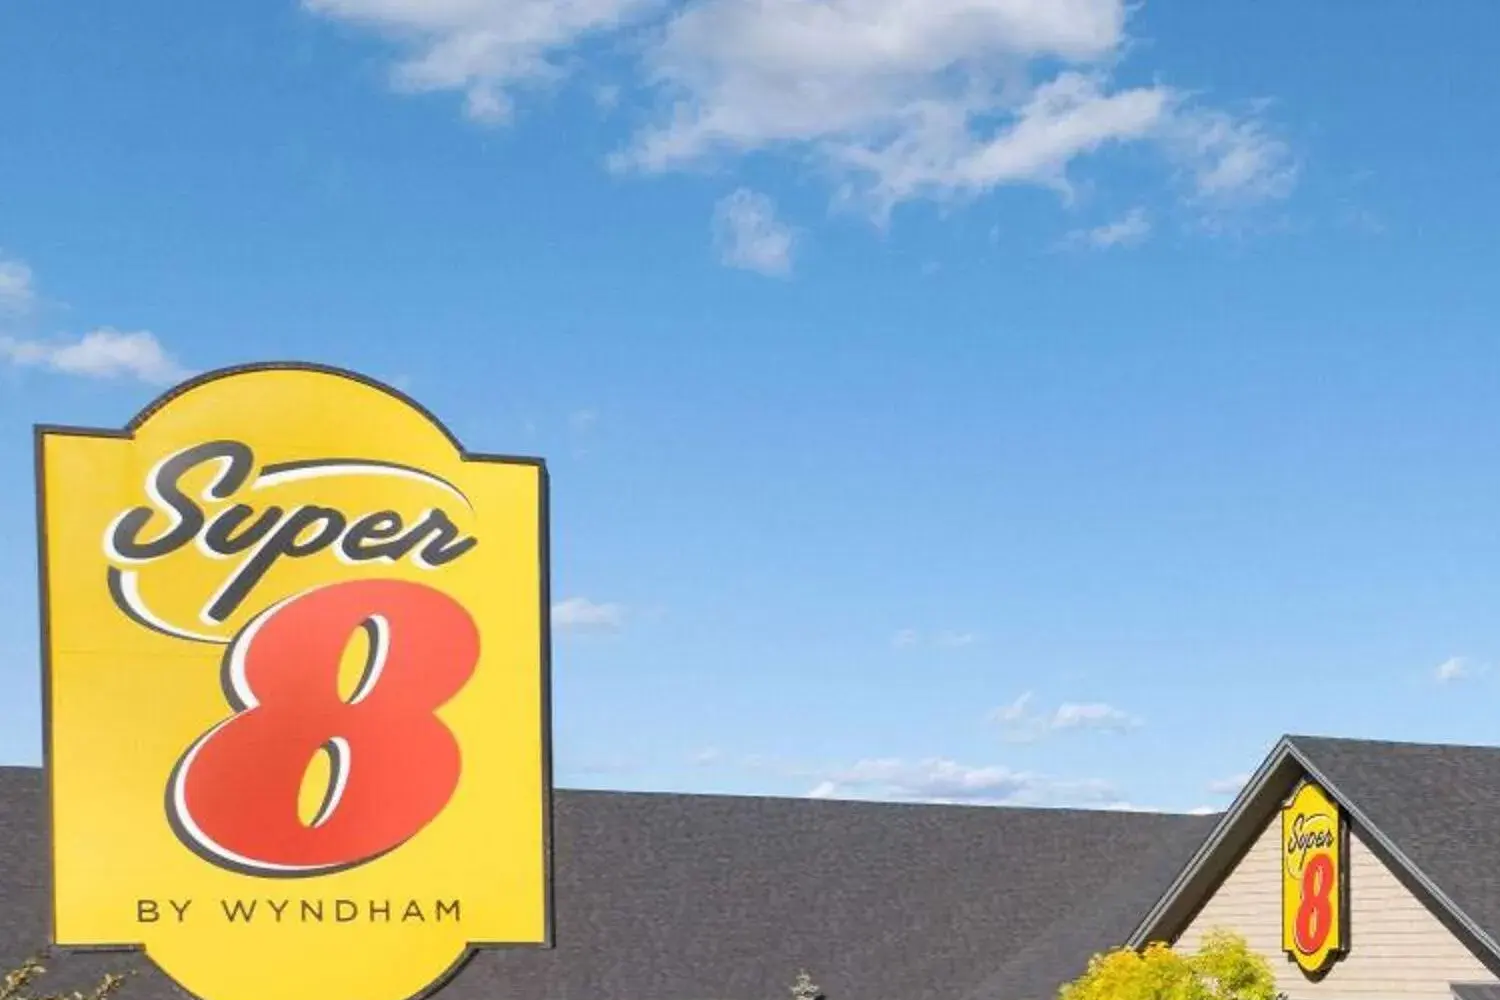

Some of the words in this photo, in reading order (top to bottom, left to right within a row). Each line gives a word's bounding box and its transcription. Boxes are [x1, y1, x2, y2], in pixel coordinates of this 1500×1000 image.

[104, 440, 477, 624] Super
[165, 578, 481, 878] 8
[1288, 813, 1333, 870] Super
[136, 899, 192, 923] BY
[222, 899, 461, 924] WYNDHAM
[1294, 853, 1334, 954] 8
